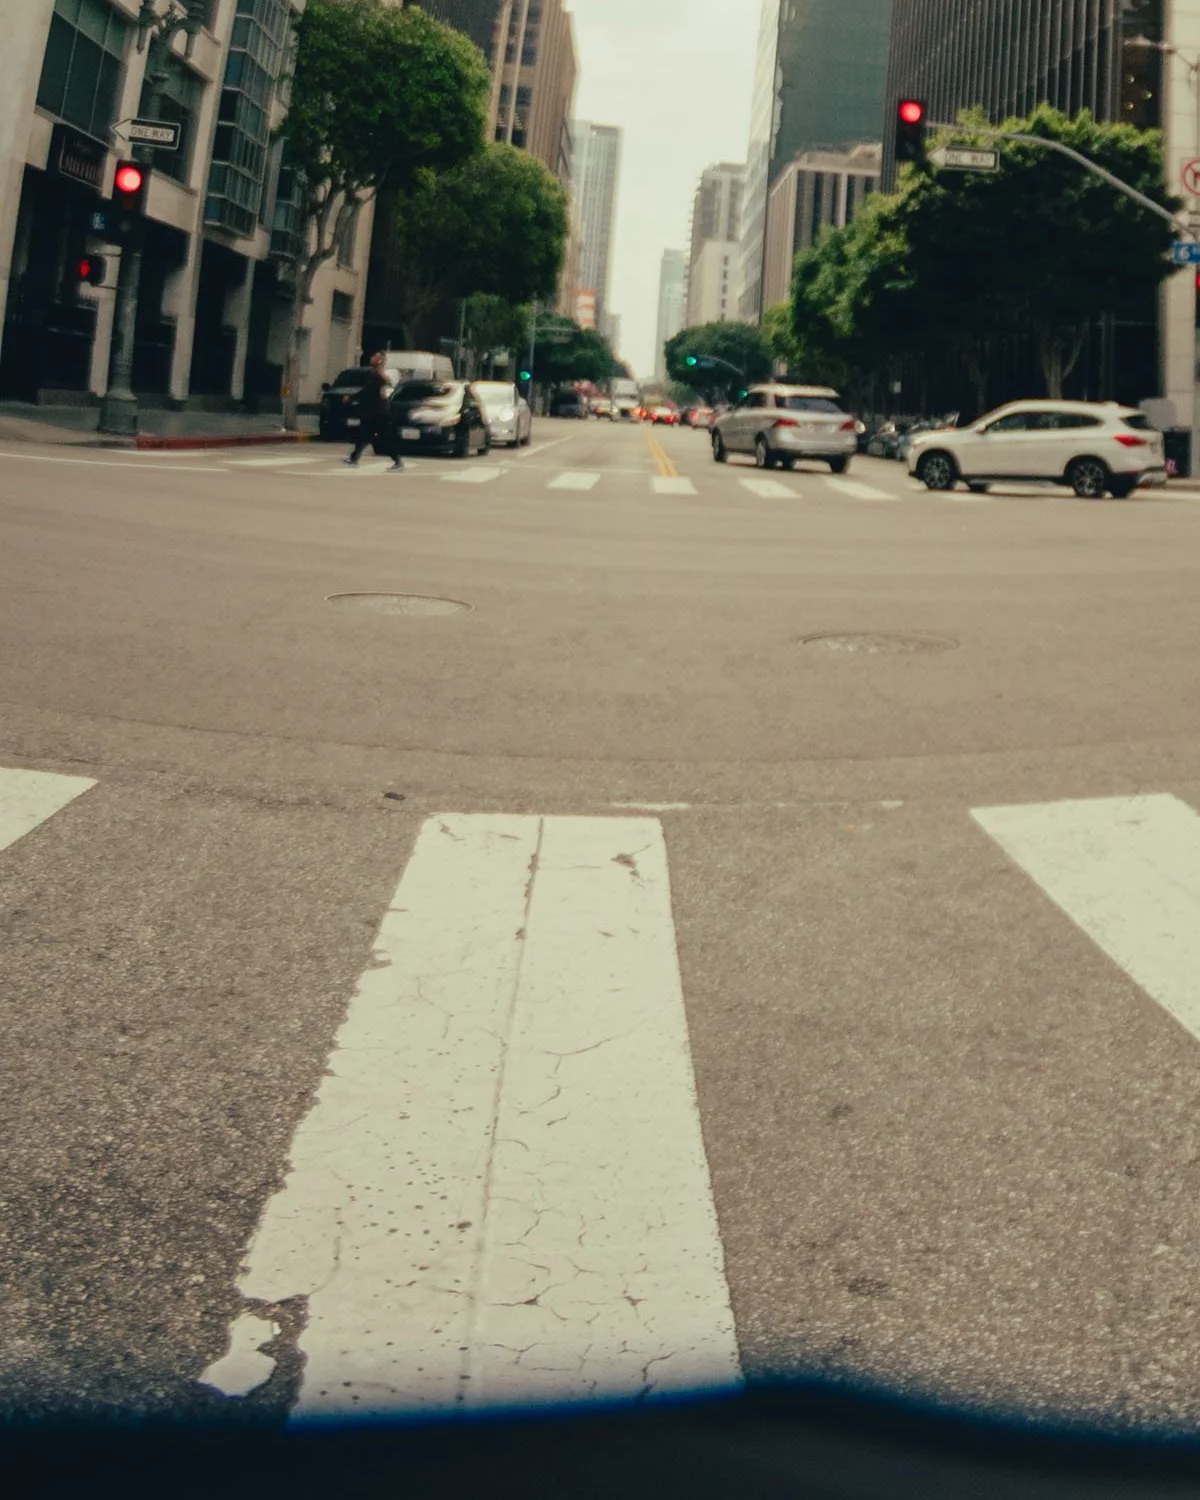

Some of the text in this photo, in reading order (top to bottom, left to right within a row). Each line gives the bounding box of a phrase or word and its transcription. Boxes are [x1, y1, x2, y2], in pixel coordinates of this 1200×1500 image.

[131, 126, 172, 138] ONE WAY
[971, 153, 993, 165] WAY
